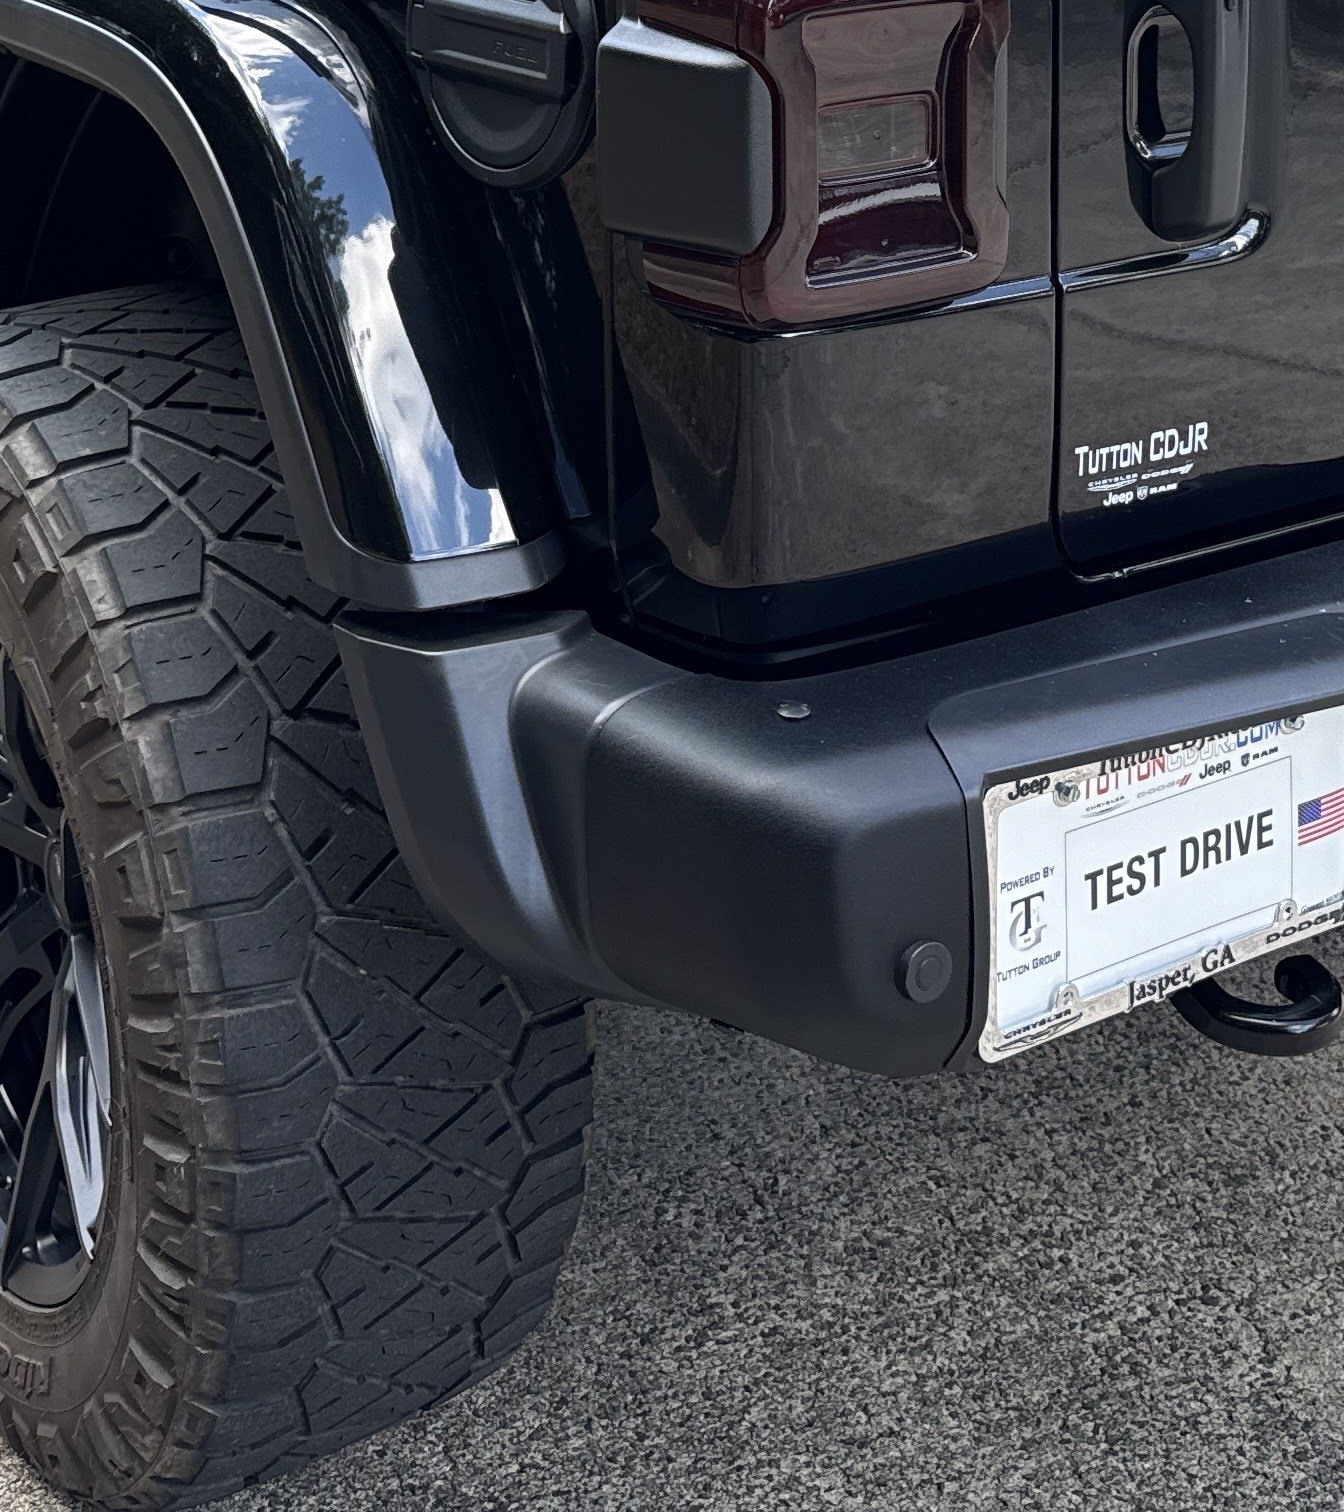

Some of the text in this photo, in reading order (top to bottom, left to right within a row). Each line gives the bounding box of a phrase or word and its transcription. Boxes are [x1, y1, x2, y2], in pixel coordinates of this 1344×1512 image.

[1149, 421, 1209, 462] CDJR
[1087, 472, 1139, 487] CHRYSLER
[1102, 482, 1178, 507] Jeep RAM
[1199, 759, 1231, 780] Jeep
[1252, 746, 1278, 760] RAM
[1008, 774, 1051, 801] Jeep
[1084, 808, 1274, 911] TEST DRIVE
[1266, 909, 1342, 945] DODGE
[1032, 950, 1061, 969] GROUP
[1129, 944, 1236, 1008] Jasper, GA
[1003, 1009, 1072, 1040] CHRYSLER
